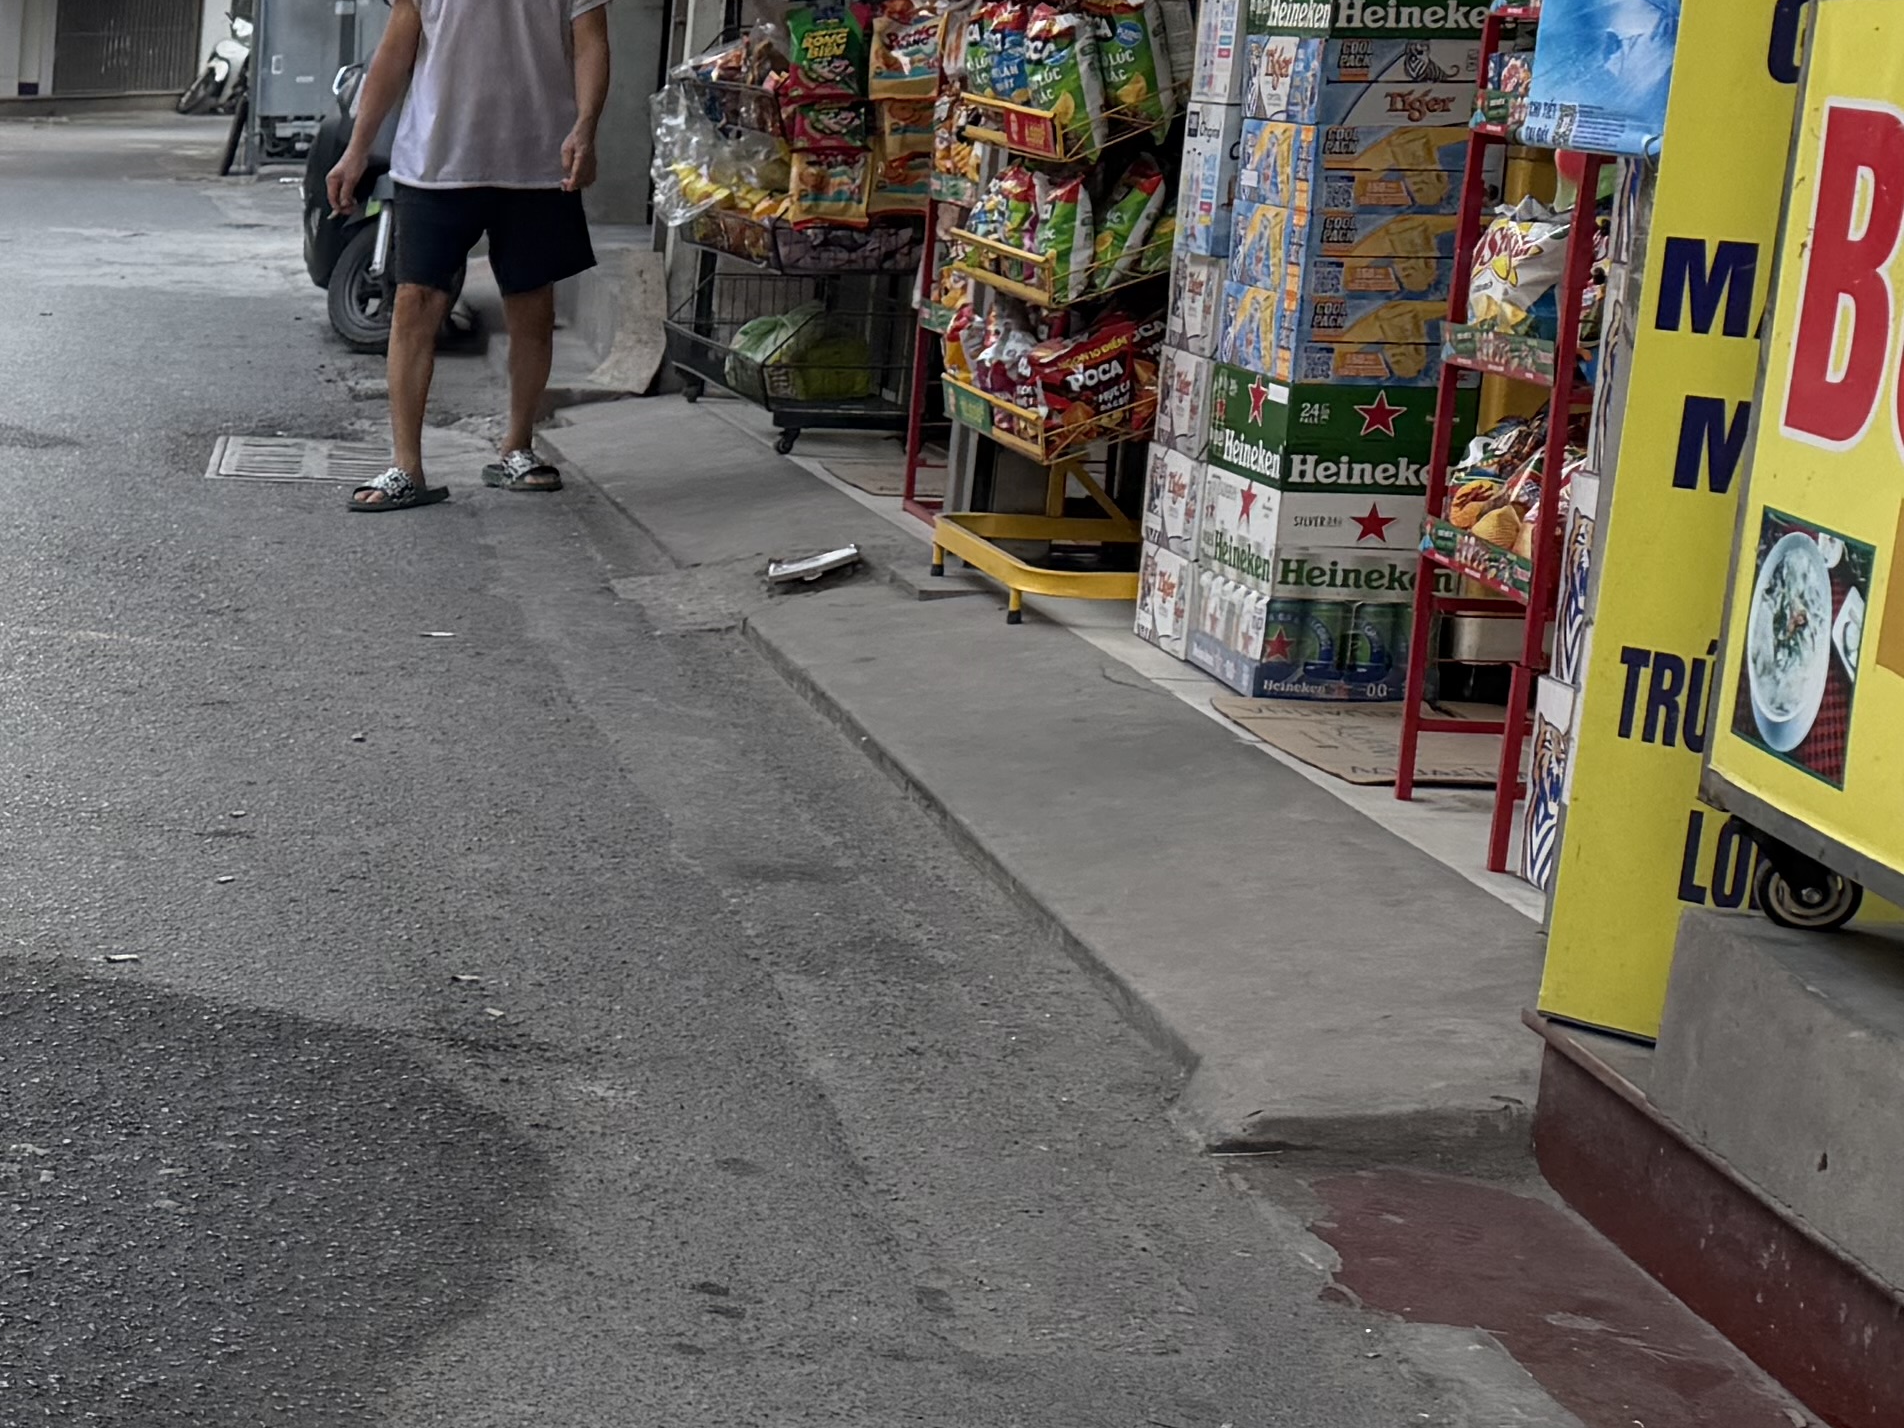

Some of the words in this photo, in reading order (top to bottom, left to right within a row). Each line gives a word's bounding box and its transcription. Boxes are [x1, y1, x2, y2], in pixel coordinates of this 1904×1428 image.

[1338, 0, 1492, 30] Heineke
[1385, 89, 1456, 122] Tiger
[1780, 96, 1904, 454] B
[1066, 359, 1124, 392] POCA
[1300, 402, 1319, 416] 24
[1223, 431, 1282, 480] Heineken
[1214, 530, 1270, 583] Heineken
[1263, 679, 1326, 693] Heineken
